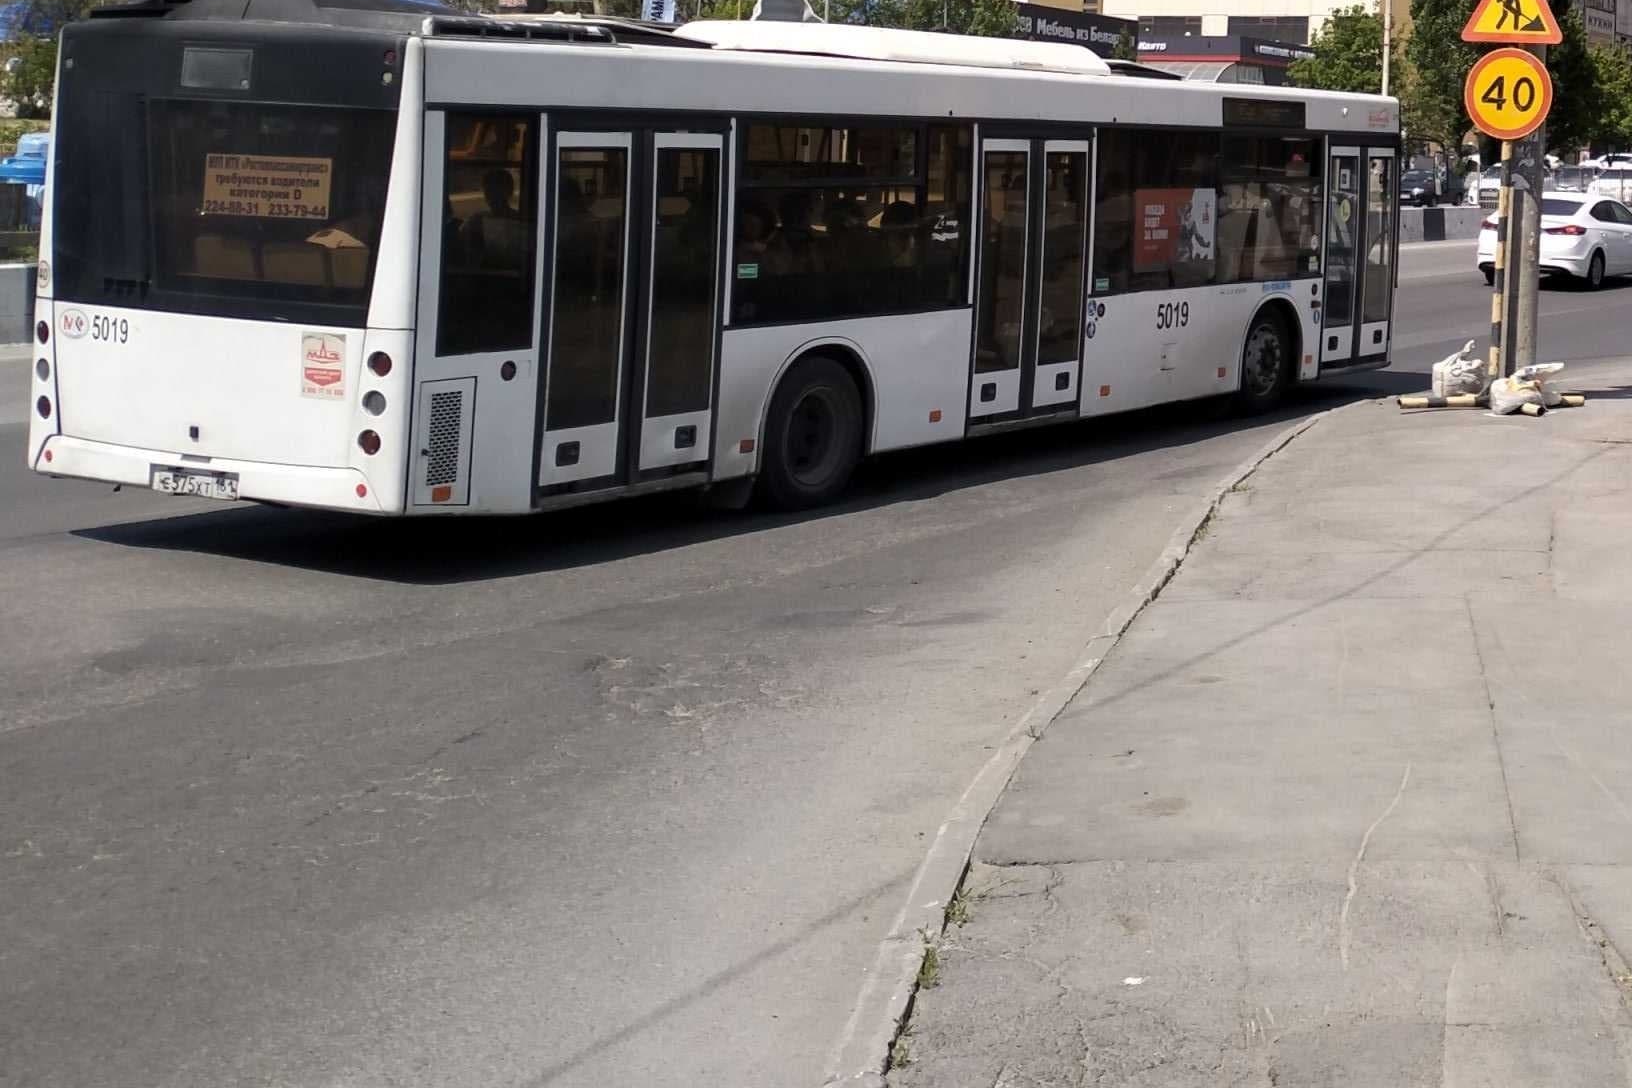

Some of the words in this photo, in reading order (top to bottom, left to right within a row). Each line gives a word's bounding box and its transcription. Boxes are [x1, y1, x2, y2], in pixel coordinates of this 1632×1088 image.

[1036, 17, 1076, 39] Мебель
[1075, 28, 1089, 40] из
[1481, 75, 1535, 112] 40
[215, 174, 268, 187] требуются
[271, 177, 320, 188] водители
[230, 189, 290, 201] категории
[294, 189, 302, 200] D
[1157, 301, 1190, 330] 5019
[92, 314, 129, 344] 5019
